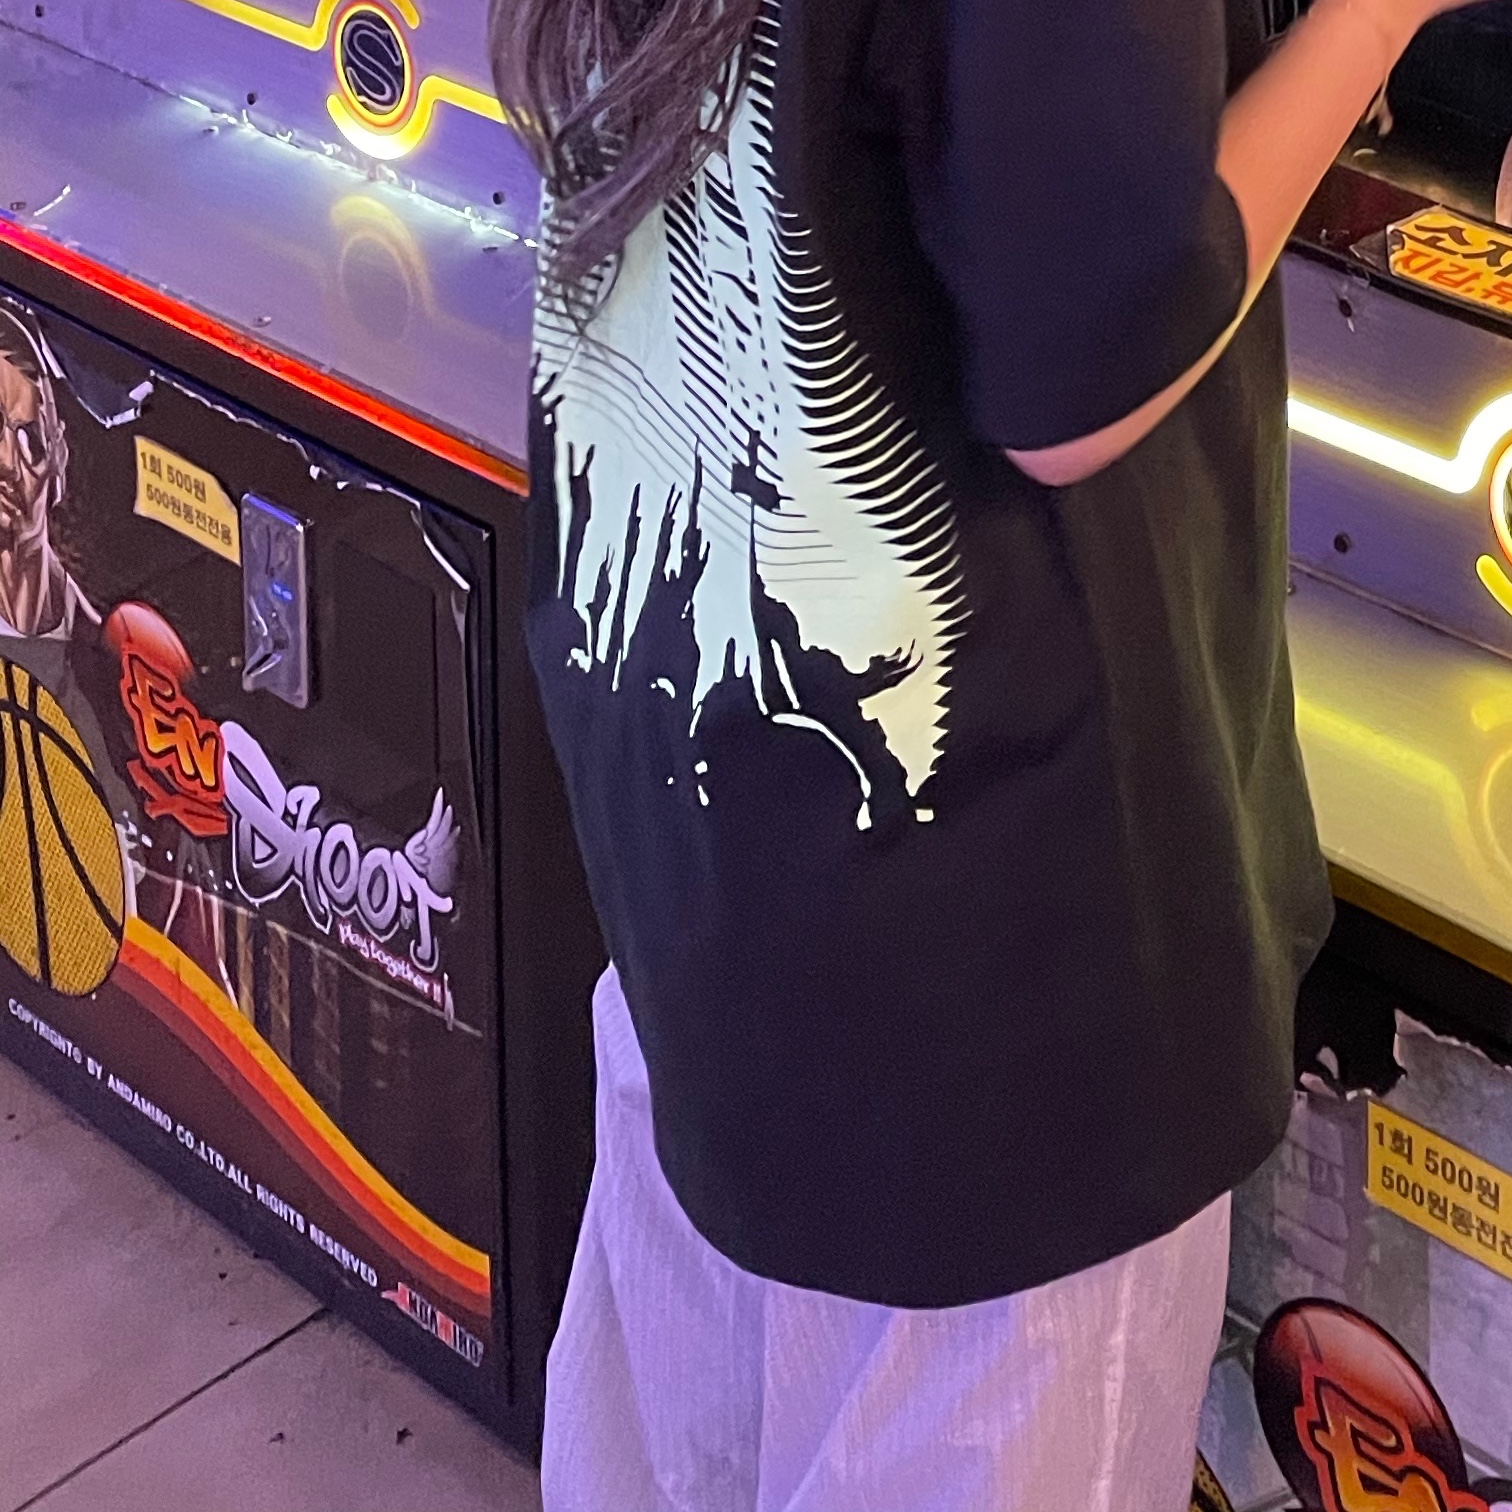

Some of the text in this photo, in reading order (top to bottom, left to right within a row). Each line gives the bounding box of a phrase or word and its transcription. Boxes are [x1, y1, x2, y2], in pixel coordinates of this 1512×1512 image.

[141, 452, 207, 503] 1회 500원
[87, 1057, 103, 1080] BY
[107, 1073, 173, 1133] ANDAMIRO
[256, 1183, 305, 1234] RIGHTS
[309, 1223, 378, 1288] RESERVED
[1374, 1121, 1500, 1215] 1회 500원
